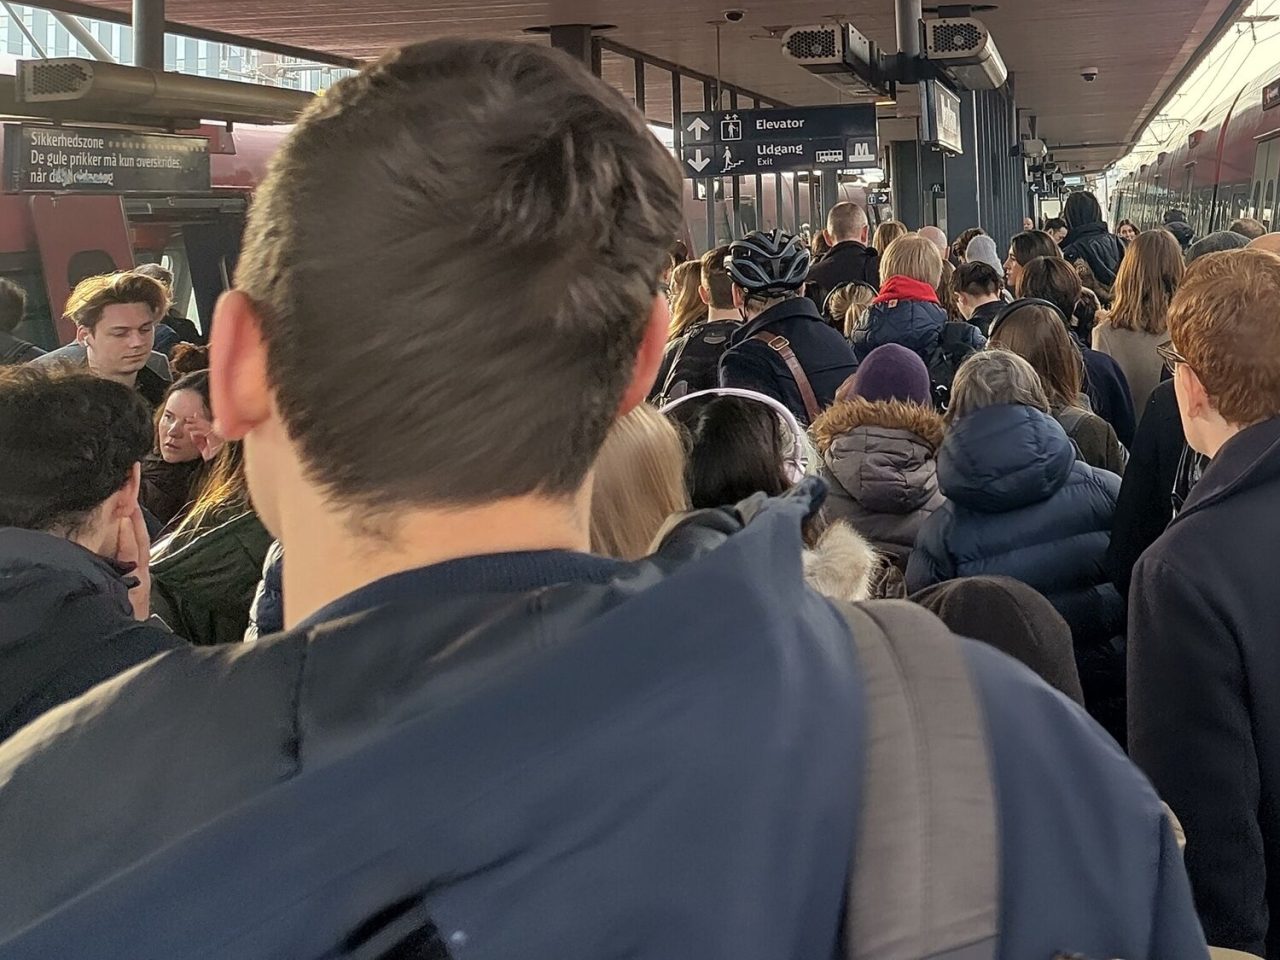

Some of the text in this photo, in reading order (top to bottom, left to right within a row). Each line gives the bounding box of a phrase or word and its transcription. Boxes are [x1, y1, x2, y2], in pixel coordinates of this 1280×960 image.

[756, 118, 804, 130] Elevator
[31, 131, 104, 149] Sikkerhedszone
[757, 144, 803, 155] Udgang
[31, 150, 44, 165] De
[47, 150, 67, 167] gule
[70, 151, 101, 170] prikker
[103, 153, 117, 167] må
[119, 153, 135, 167] kun
[757, 157, 773, 166] Exit
[30, 168, 46, 183] når
